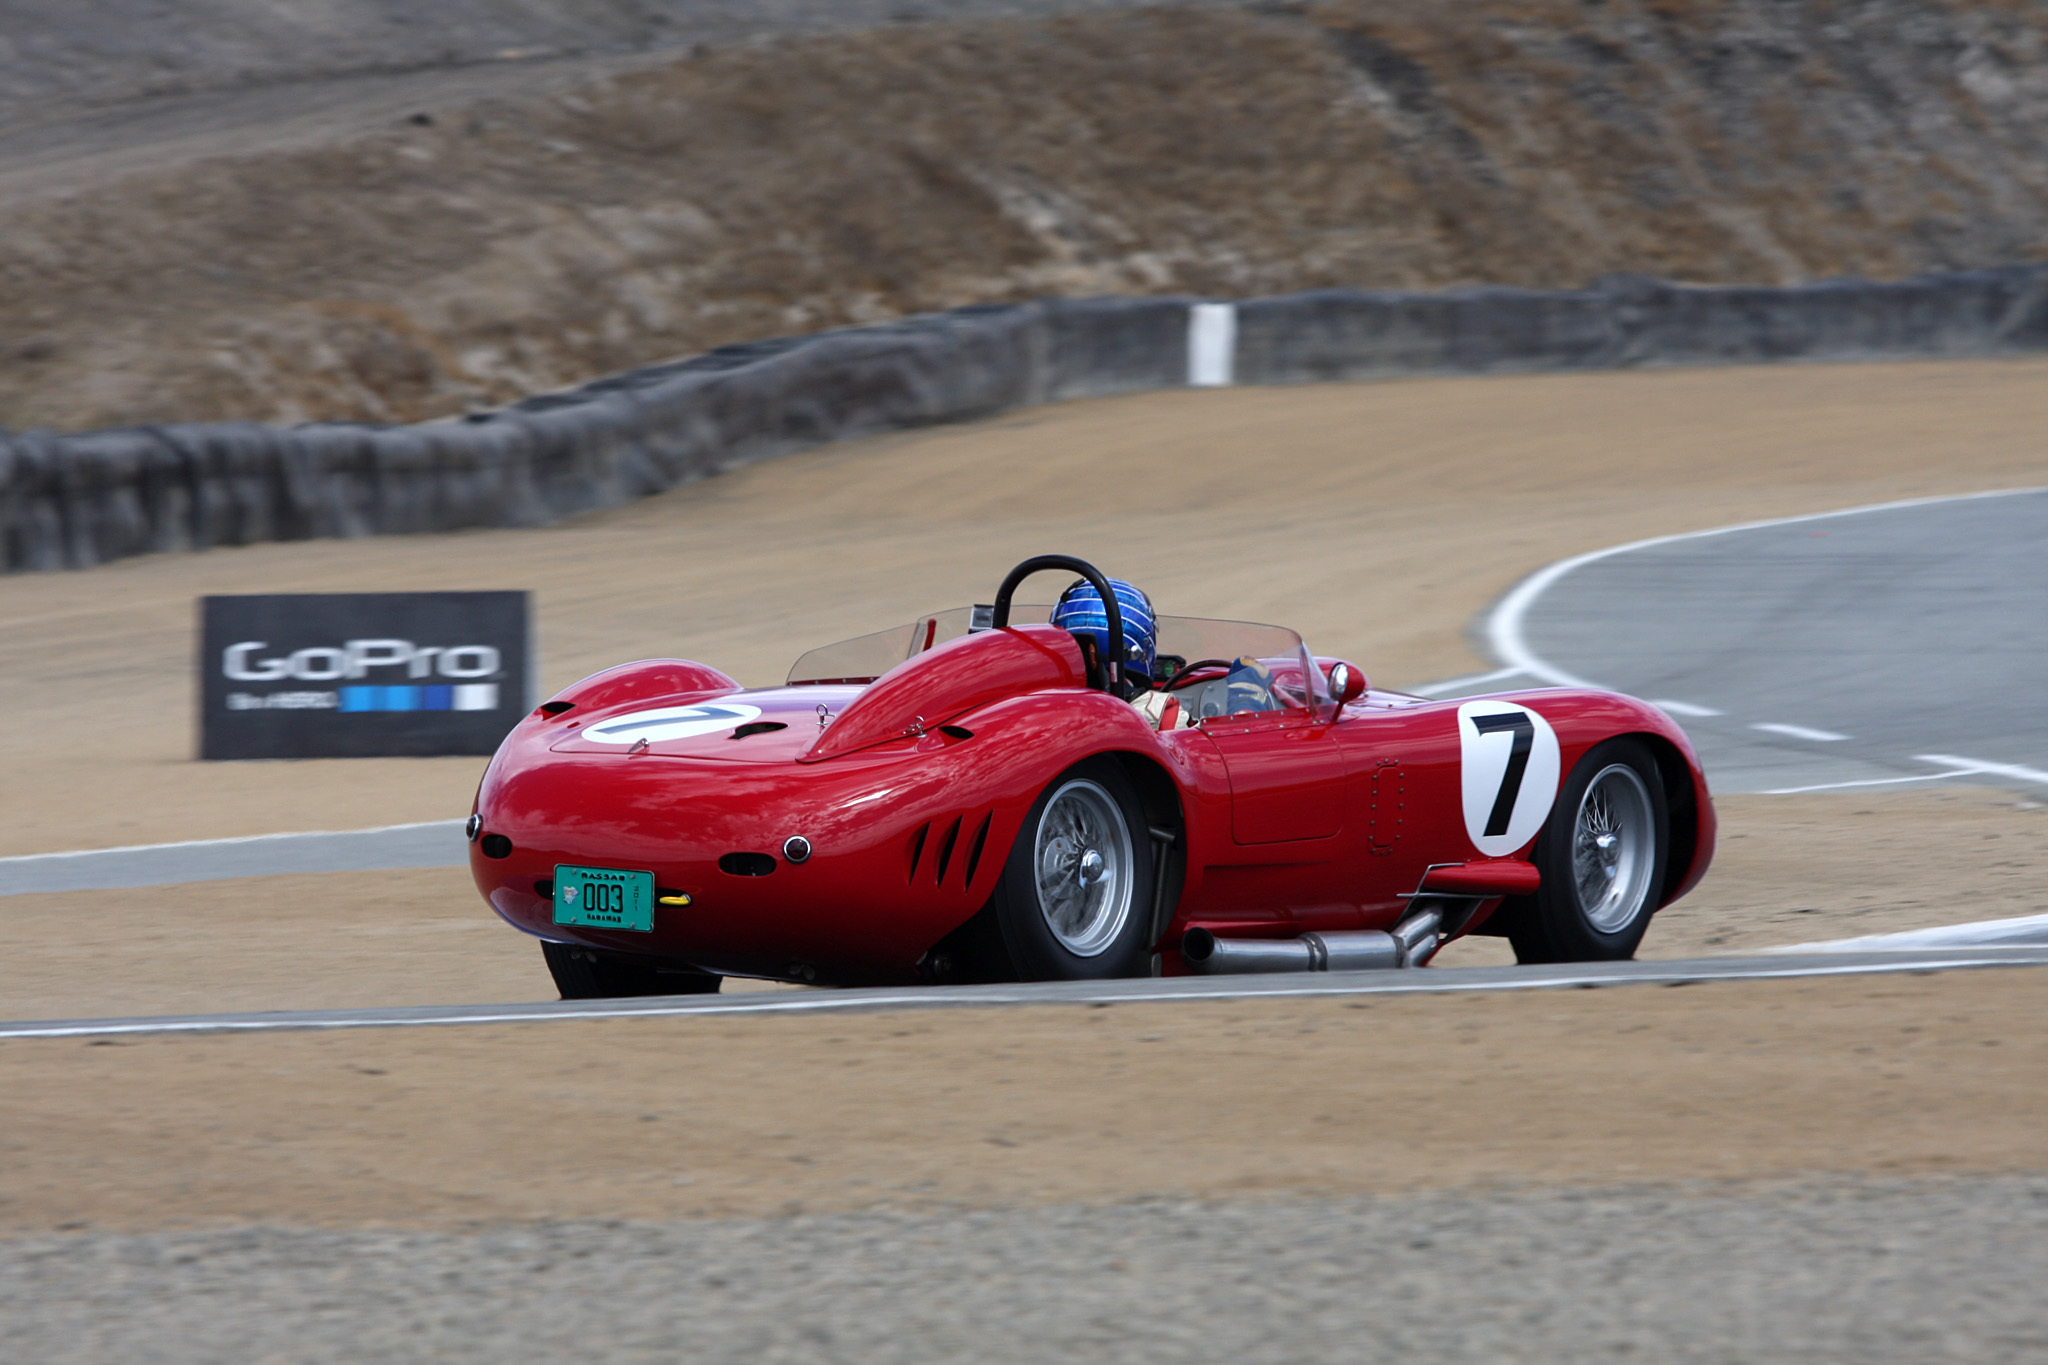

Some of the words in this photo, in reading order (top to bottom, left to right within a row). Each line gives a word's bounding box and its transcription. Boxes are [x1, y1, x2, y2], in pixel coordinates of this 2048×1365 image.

[222, 639, 501, 681] GoPro
[1470, 712, 1535, 836] 7
[583, 883, 623, 914] 003
